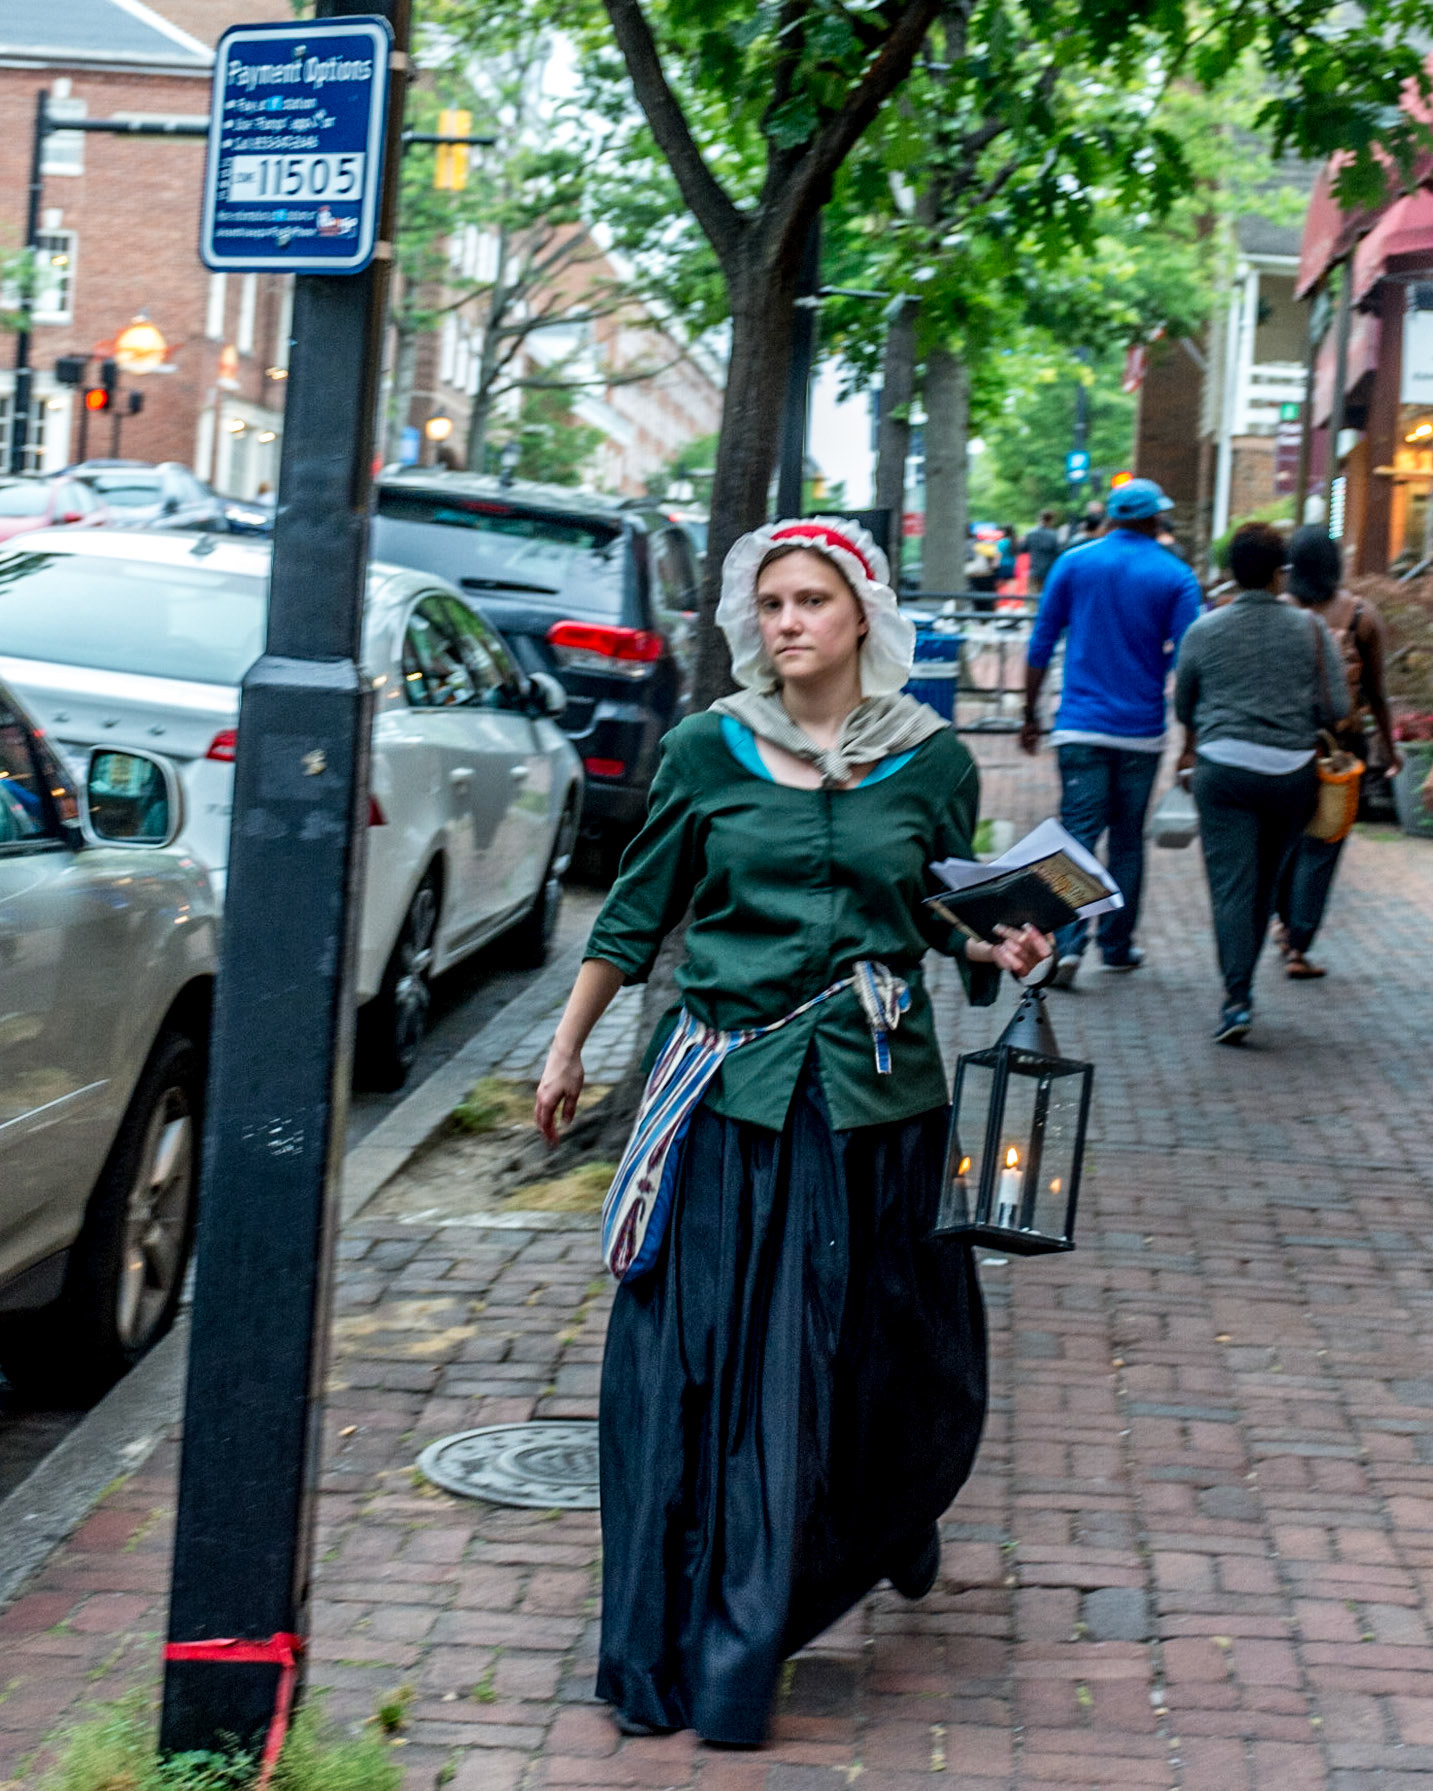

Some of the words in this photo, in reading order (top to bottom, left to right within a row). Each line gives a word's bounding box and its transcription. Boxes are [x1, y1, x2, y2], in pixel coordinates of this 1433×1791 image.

[228, 58, 302, 92] Payment
[303, 55, 372, 90] Options
[258, 157, 357, 196] 11505
